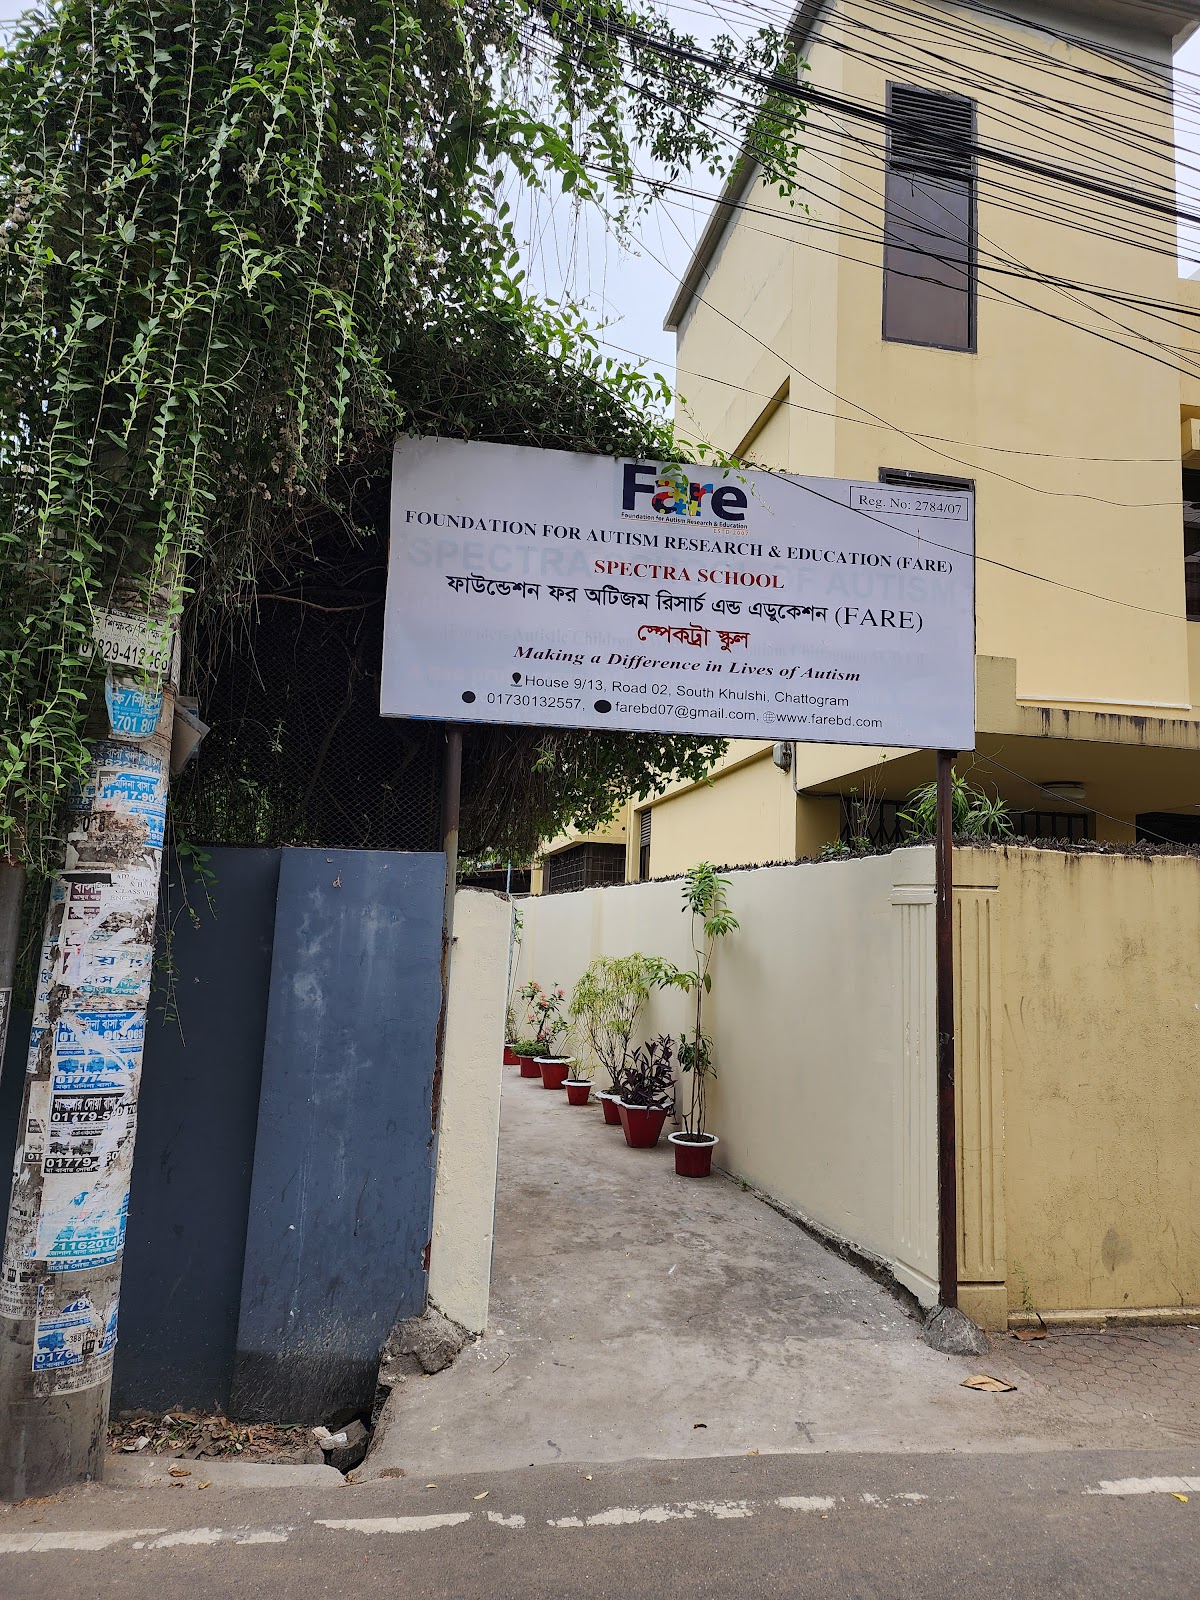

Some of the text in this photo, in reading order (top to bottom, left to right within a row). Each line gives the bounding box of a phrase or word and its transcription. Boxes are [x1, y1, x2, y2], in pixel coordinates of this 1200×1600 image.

[622, 463, 748, 521] Fare
[858, 494, 962, 515] Reg. No: 2784/07
[621, 511, 655, 520] Foundation
[665, 516, 686, 524] Autism
[686, 518, 713, 527] Research
[719, 521, 748, 530] Education
[405, 510, 953, 575] FOUNDATION FOR AUTISM RESEARCH & EDUCATION (FARE)
[594, 559, 691, 581] SPECTRA
[698, 568, 785, 589] SCHOOL
[445, 572, 923, 633] ফাউন্ডেশন ফর অটিজম রিসার্চ এন্ড এডুকেশন (FARE)
[716, 629, 750, 652] স্কুল
[513, 646, 861, 682] Making a Difference in Lives of Autism
[525, 675, 849, 707] House 9/13, Road 02, South Khulshi, Chattogram
[487, 692, 883, 728] 01730132557, farebd07@gmail.com, www.farebd.com
